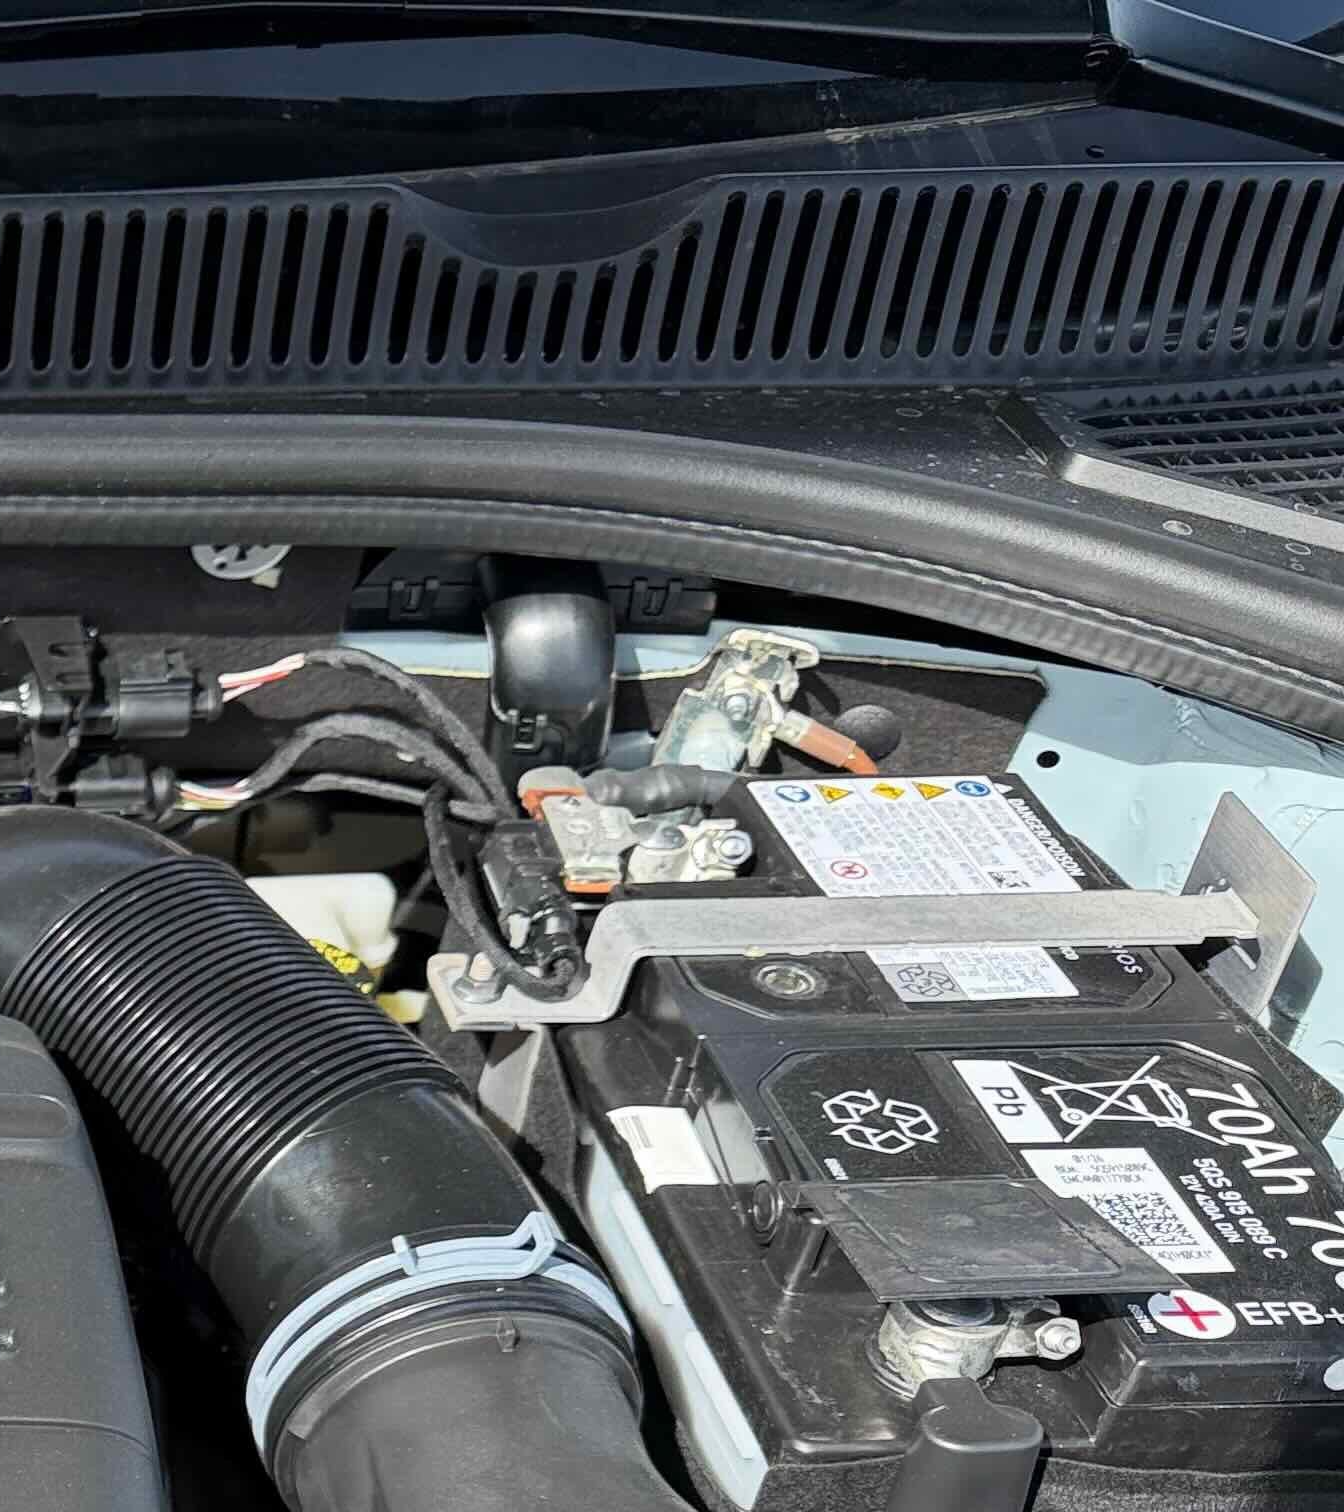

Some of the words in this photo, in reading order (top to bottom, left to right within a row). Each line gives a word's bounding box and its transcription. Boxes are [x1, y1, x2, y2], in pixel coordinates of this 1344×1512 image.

[982, 1086, 1024, 1117] Pb
[1186, 1082, 1316, 1195] 70Ah
[1179, 1174, 1205, 1193] 12V
[1194, 1193, 1224, 1223] 420A
[1214, 1222, 1245, 1244] DIN
[1219, 1189, 1255, 1217] 915
[1263, 1246, 1289, 1261] C
